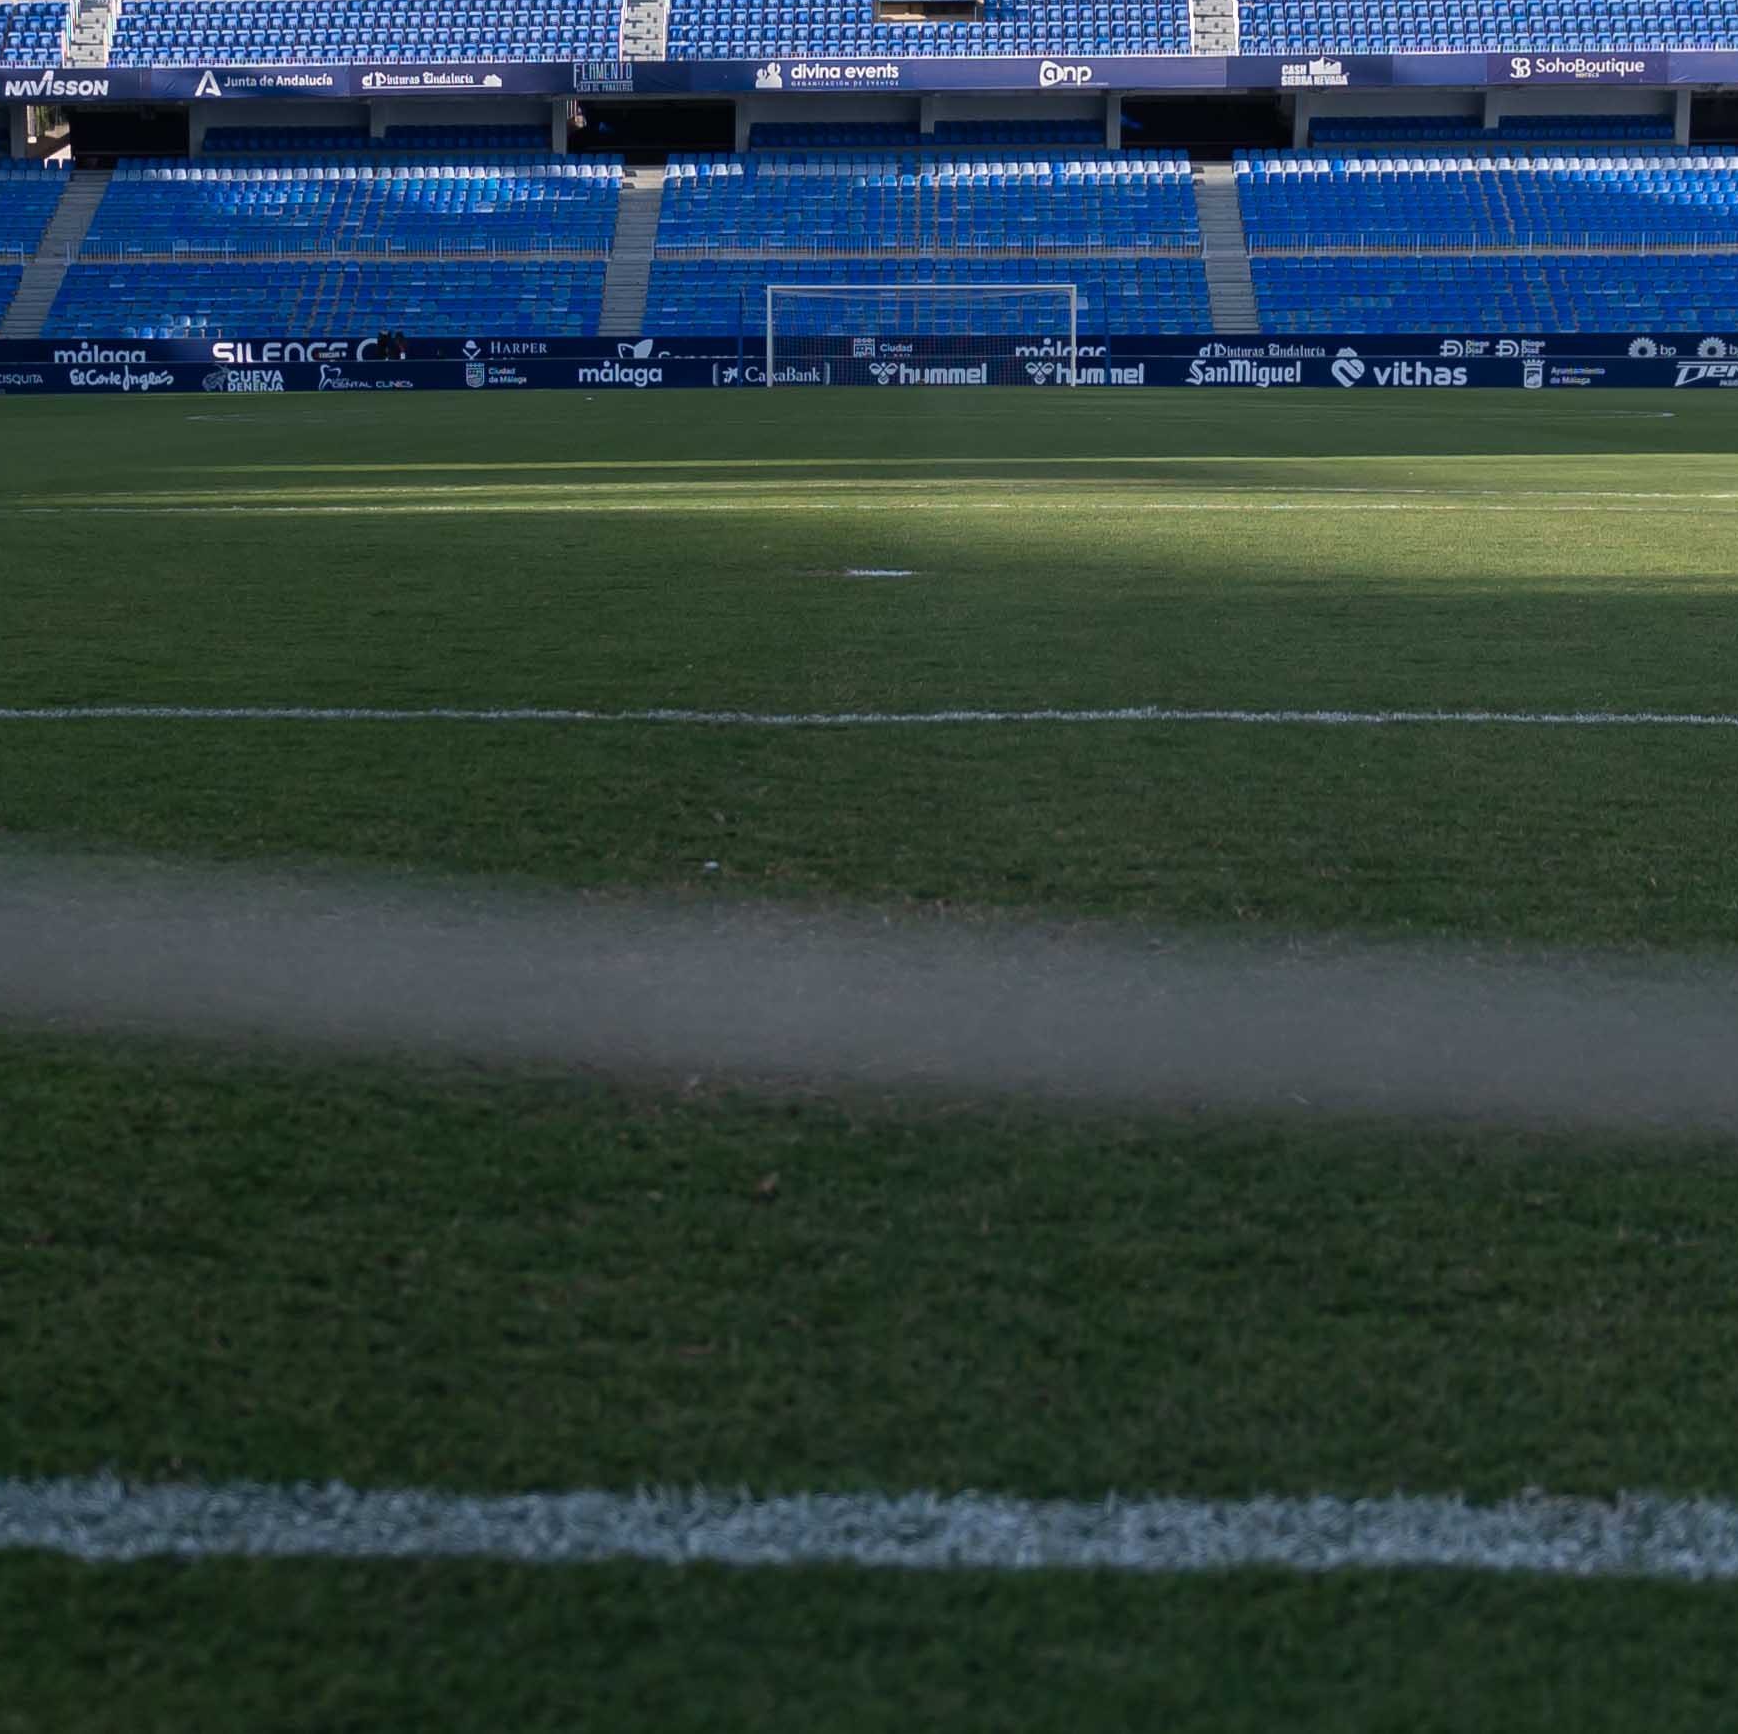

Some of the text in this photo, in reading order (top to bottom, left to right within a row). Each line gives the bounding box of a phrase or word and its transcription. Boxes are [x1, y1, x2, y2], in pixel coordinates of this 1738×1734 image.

[791, 63, 899, 79] divina events
[1282, 64, 1307, 74] CASH
[5, 70, 109, 96] NAVISSON
[224, 73, 333, 87] Junta de Andalucía
[375, 71, 420, 86] Pinturas
[490, 341, 547, 354] HARPER
[880, 343, 913, 352] Ciudad
[1214, 342, 1264, 357] Pinturas
[1660, 344, 1676, 357] bp
[227, 370, 284, 382] CUEVA
[488, 367, 516, 375] Ciudad
[745, 366, 821, 384] CaxaBank
[900, 363, 987, 384] hummel
[1373, 362, 1468, 386] vithas
[488, 375, 499, 384] de
